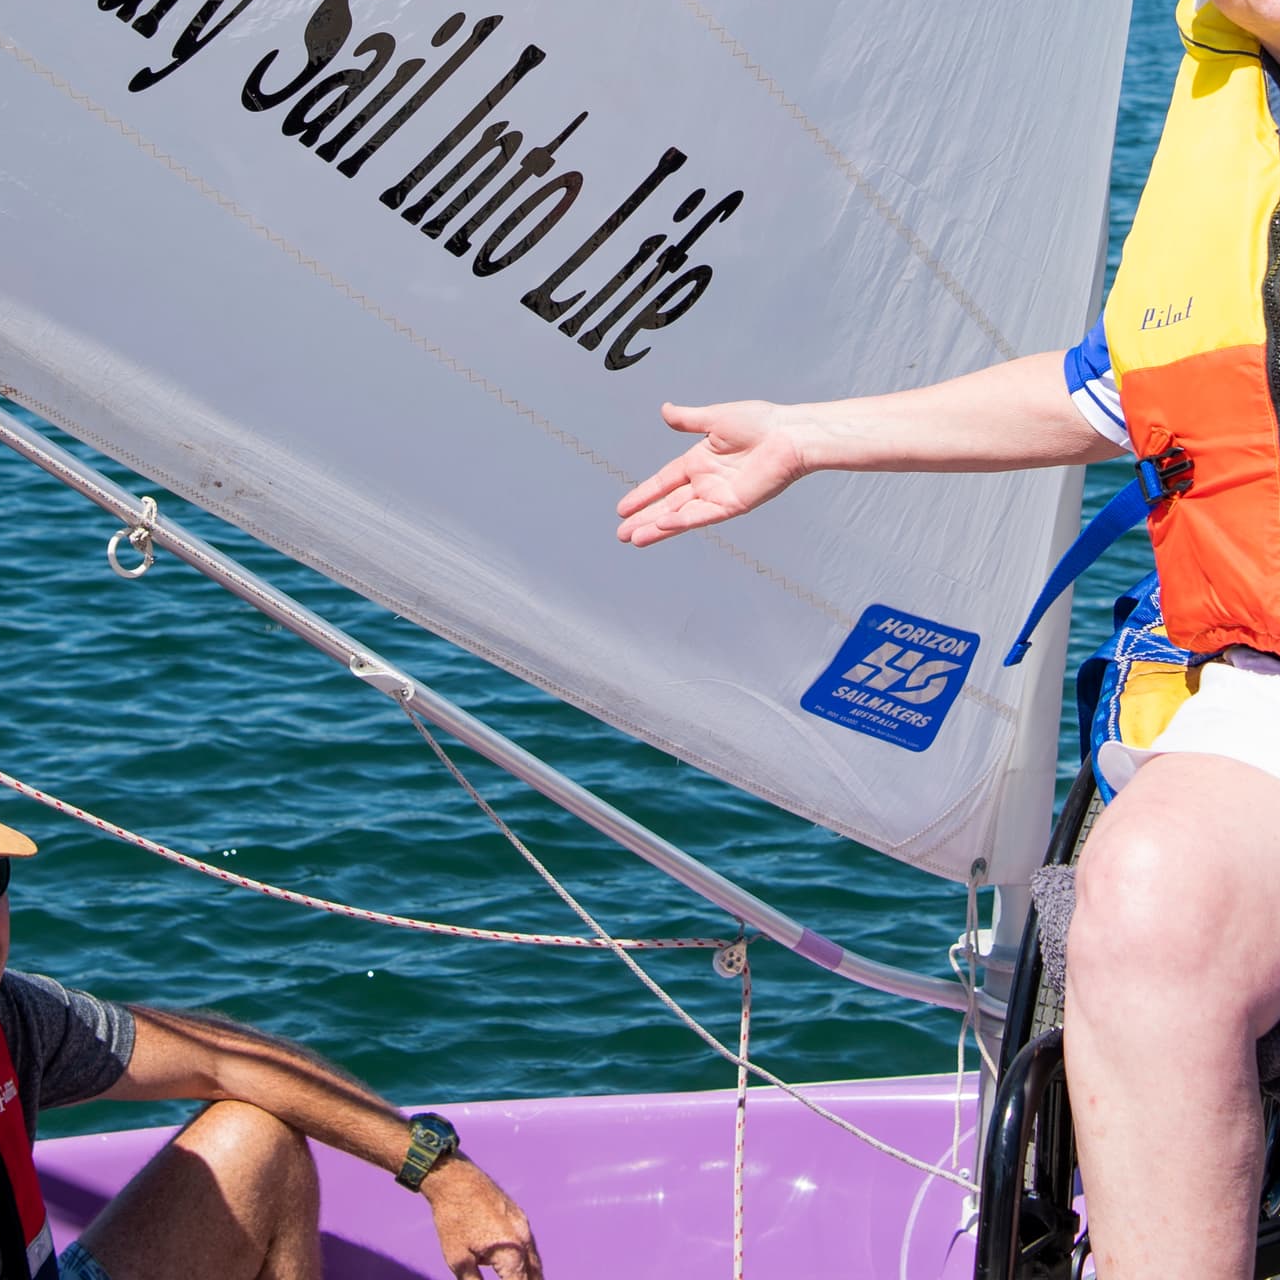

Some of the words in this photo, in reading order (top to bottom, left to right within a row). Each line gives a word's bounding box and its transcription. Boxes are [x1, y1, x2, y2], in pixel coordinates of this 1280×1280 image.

[379, 44, 588, 278] Into
[520, 146, 744, 371] Life
[876, 617, 972, 657] HORIZON
[831, 686, 933, 728] SAILMAKERS
[849, 708, 900, 730] AUSTRALIA
